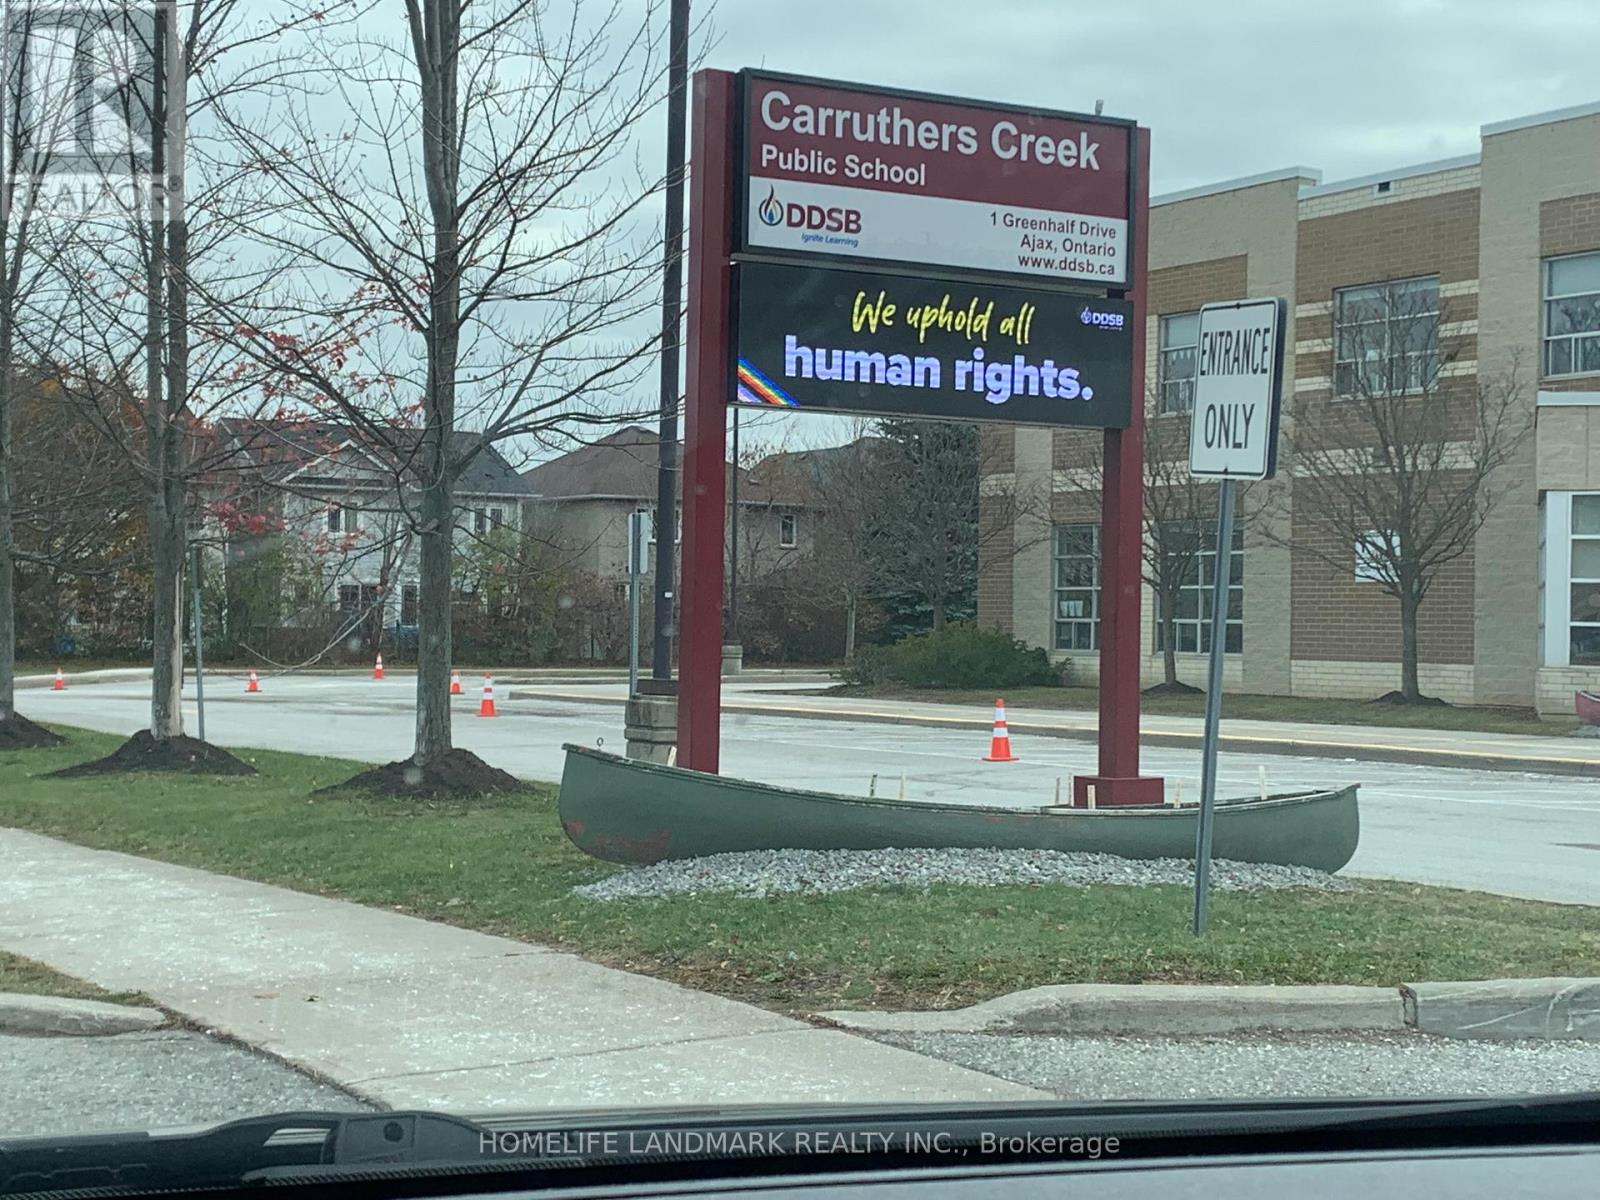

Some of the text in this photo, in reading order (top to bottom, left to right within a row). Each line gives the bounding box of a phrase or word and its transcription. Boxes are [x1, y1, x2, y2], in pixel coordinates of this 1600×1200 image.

[761, 90, 1100, 171] Carruthers Creek
[761, 143, 926, 186] Public School
[786, 203, 862, 234] DDSB
[990, 211, 1117, 239] 1 Greenhalf Drive
[801, 232, 859, 248] Ignite Learning
[1020, 234, 1116, 257] Ajax, Ontario
[1018, 255, 1115, 275] www.ddsb.ca
[852, 290, 1036, 346] We uphold all
[1092, 312, 1124, 326] DDSB
[784, 334, 1094, 404] human rights.
[1200, 327, 1270, 376] ENTRANCE
[1204, 403, 1255, 449] ONLY
